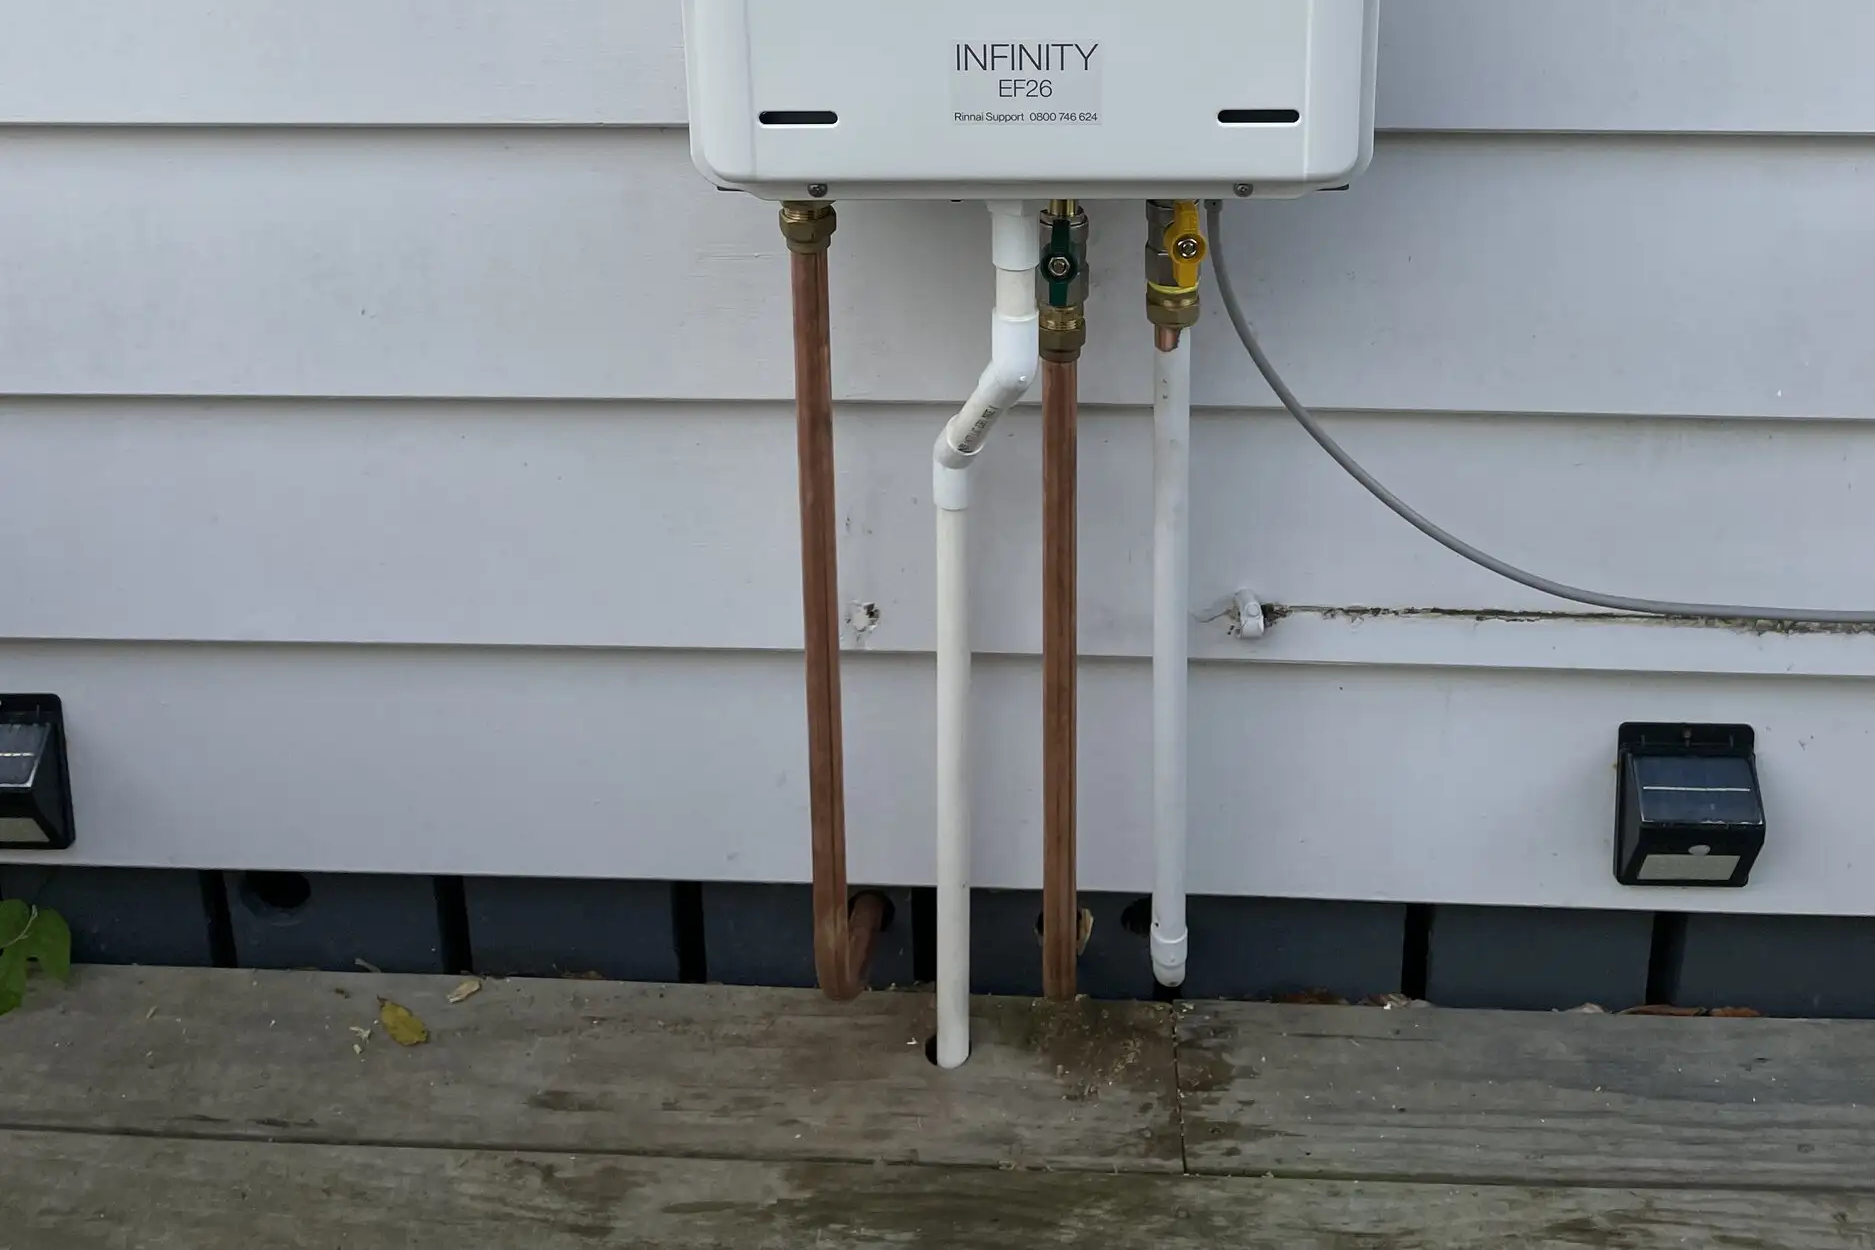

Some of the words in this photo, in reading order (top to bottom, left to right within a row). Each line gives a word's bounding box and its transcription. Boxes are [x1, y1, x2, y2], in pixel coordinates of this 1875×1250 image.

[956, 43, 1099, 71] INFINITY
[998, 79, 1053, 98] EF26
[954, 111, 984, 122] Rinnai
[985, 111, 1025, 123] Support
[1029, 111, 1057, 122] 0800
[1058, 111, 1077, 122] 746
[1078, 111, 1099, 122] 624
